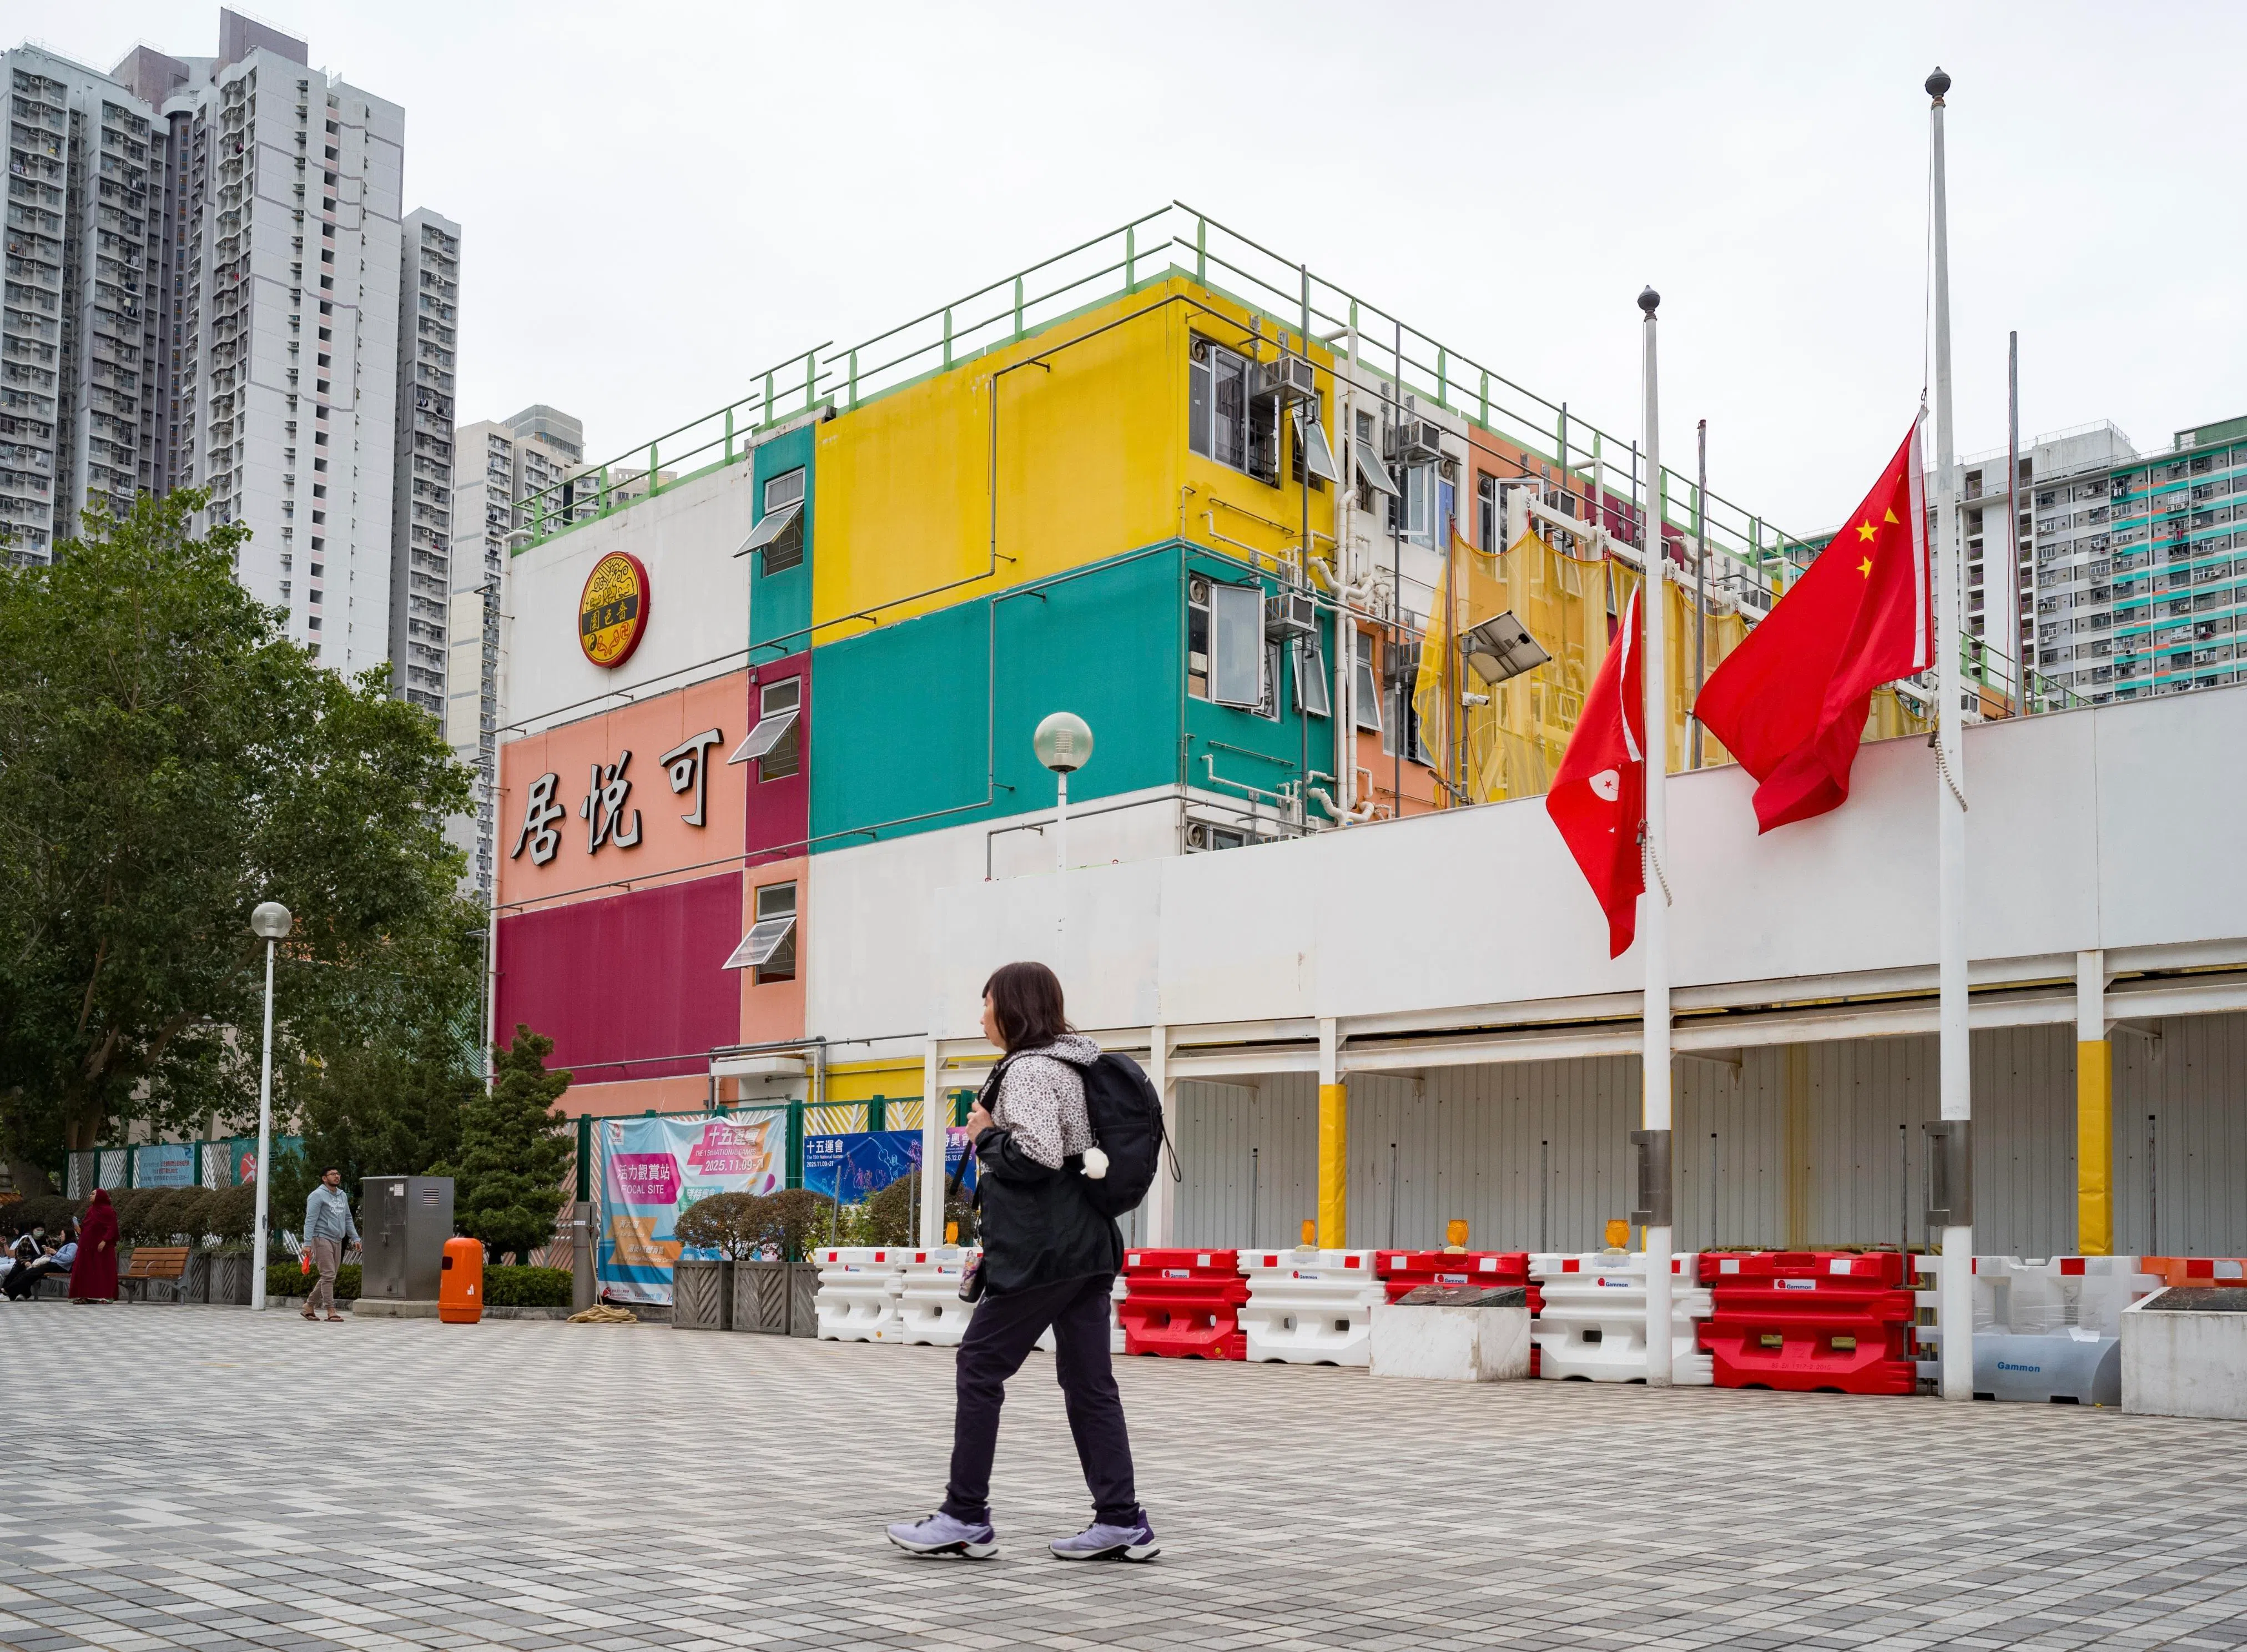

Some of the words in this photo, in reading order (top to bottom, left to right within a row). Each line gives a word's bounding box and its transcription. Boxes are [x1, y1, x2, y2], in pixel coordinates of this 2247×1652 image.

[807, 1139, 844, 1154] 十五運會
[617, 1164, 670, 1180] 活力觀賞站
[621, 1184, 645, 1194] FOCAL
[648, 1184, 664, 1194] SITE
[1998, 1362, 2041, 1373] Gammon
